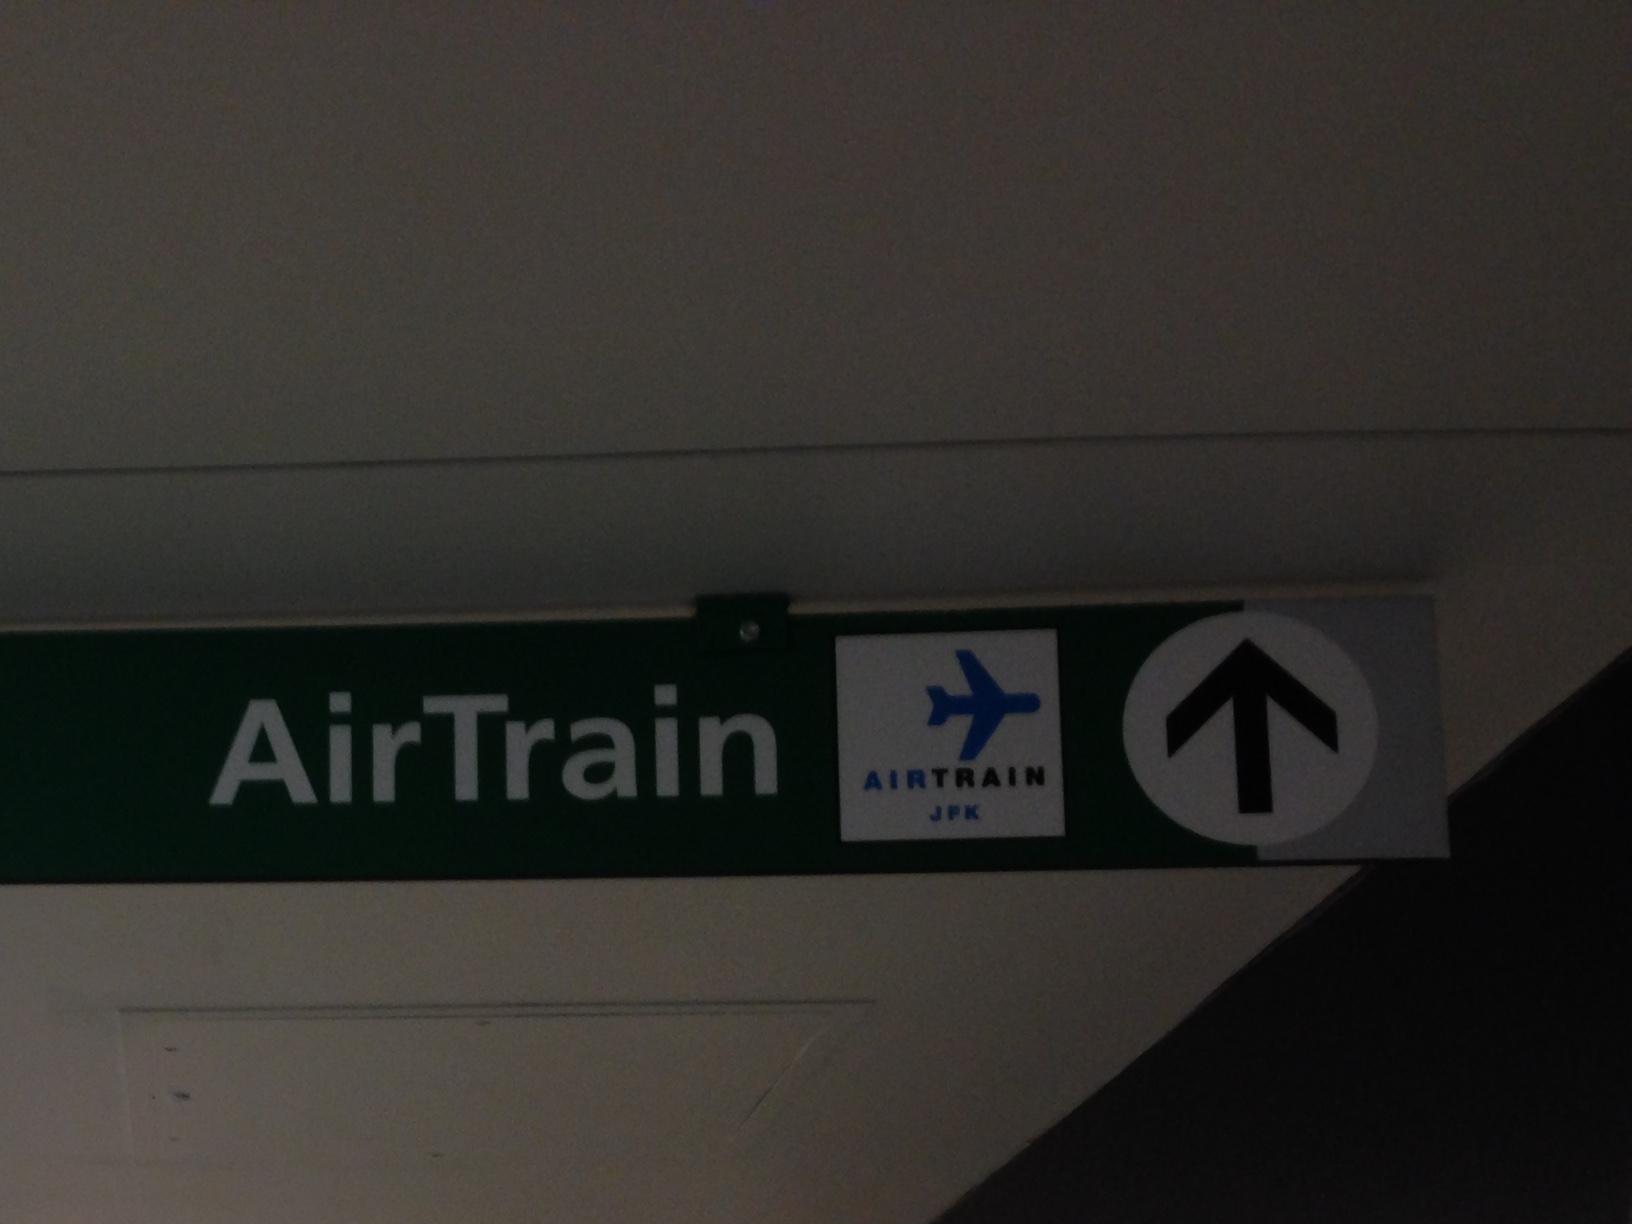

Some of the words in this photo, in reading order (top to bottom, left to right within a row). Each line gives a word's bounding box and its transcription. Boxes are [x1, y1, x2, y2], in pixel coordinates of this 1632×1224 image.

[208, 684, 779, 806] AirTrain
[863, 765, 1046, 791] AIRTRAIN
[928, 804, 980, 823] JFK
